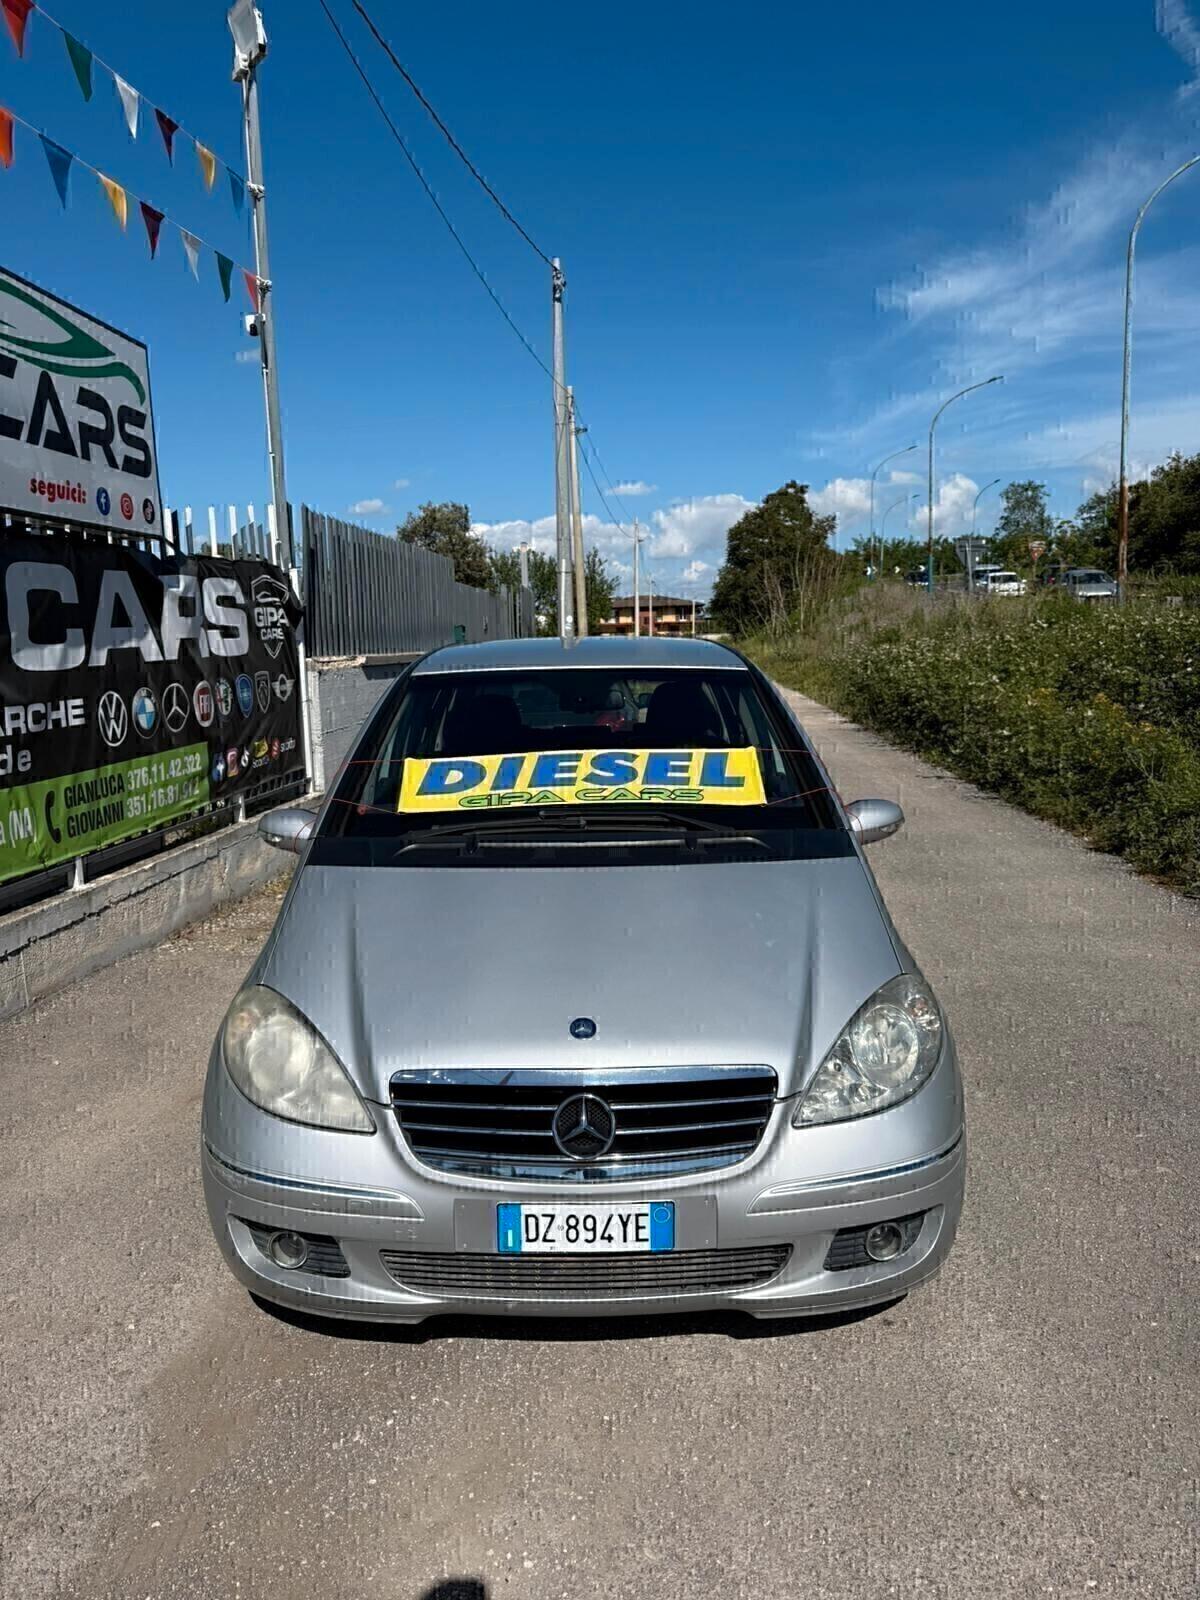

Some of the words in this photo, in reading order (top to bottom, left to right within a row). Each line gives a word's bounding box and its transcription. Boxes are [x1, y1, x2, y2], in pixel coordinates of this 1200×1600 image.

[5, 561, 249, 671] CARS
[254, 606, 289, 628] GIPA
[260, 628, 285, 640] CARS
[0, 698, 86, 737] RCHE
[64, 773, 125, 809] GIANLUCA
[127, 752, 202, 791] 376.11.42.322
[416, 751, 746, 796] DIESEL
[458, 789, 567, 808] GIPA
[574, 787, 705, 802] CARS
[66, 800, 125, 838] GIOVANNI
